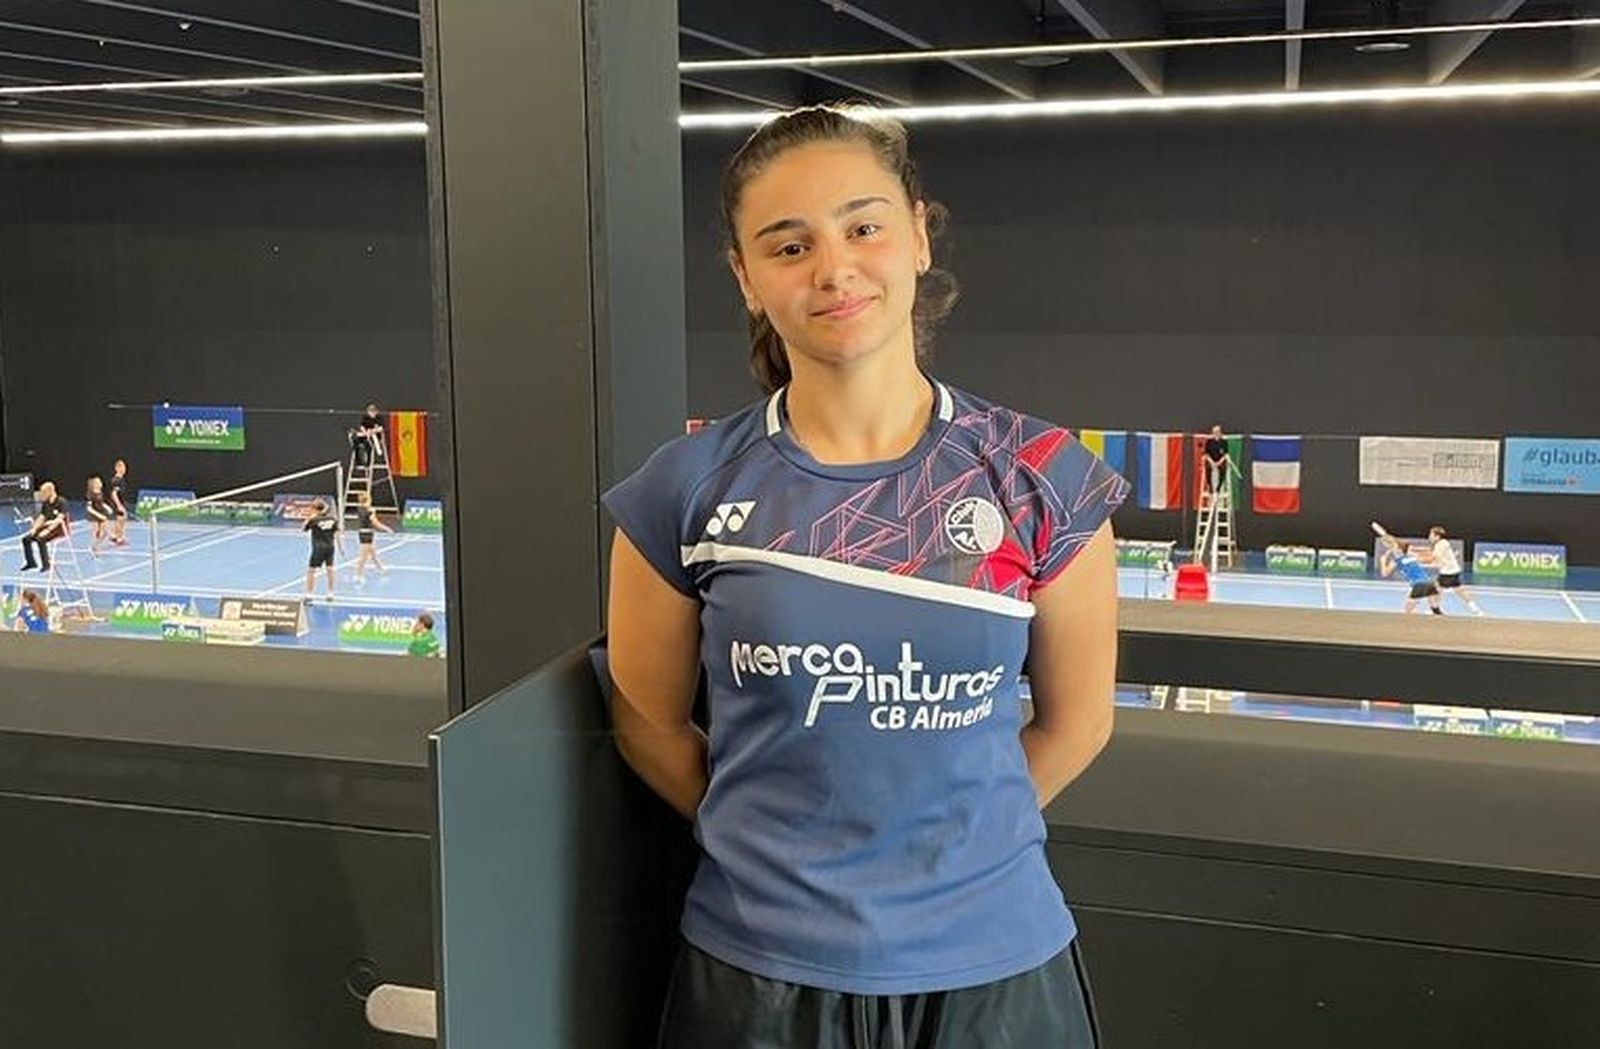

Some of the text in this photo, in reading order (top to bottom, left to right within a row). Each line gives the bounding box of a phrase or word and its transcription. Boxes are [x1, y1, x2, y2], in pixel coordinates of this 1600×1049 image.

[187, 419, 230, 437] YONEX
[1509, 552, 1560, 570] YONEX
[870, 705, 906, 730] CB
